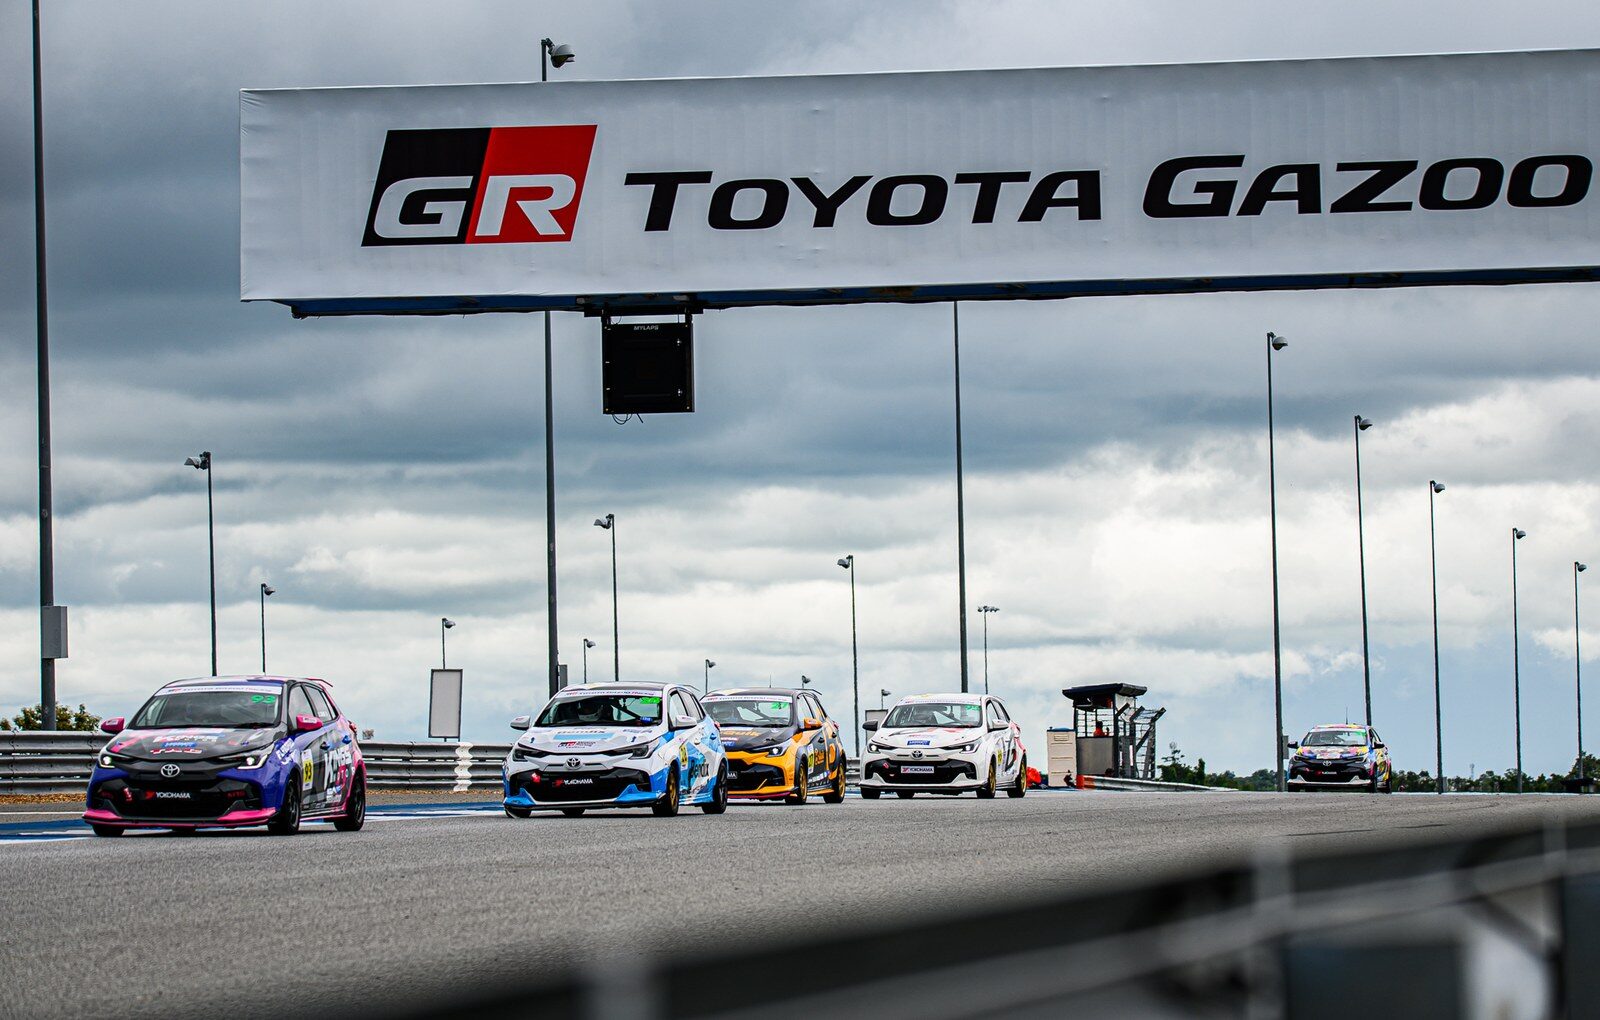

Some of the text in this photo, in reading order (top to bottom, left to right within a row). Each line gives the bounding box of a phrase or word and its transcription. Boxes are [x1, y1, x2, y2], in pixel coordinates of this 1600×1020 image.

[373, 154, 1594, 239] GR TOYOTA GAZOO
[250, 694, 277, 705] 93
[304, 762, 312, 781] 93
[155, 791, 191, 799] YOKOHAMA
